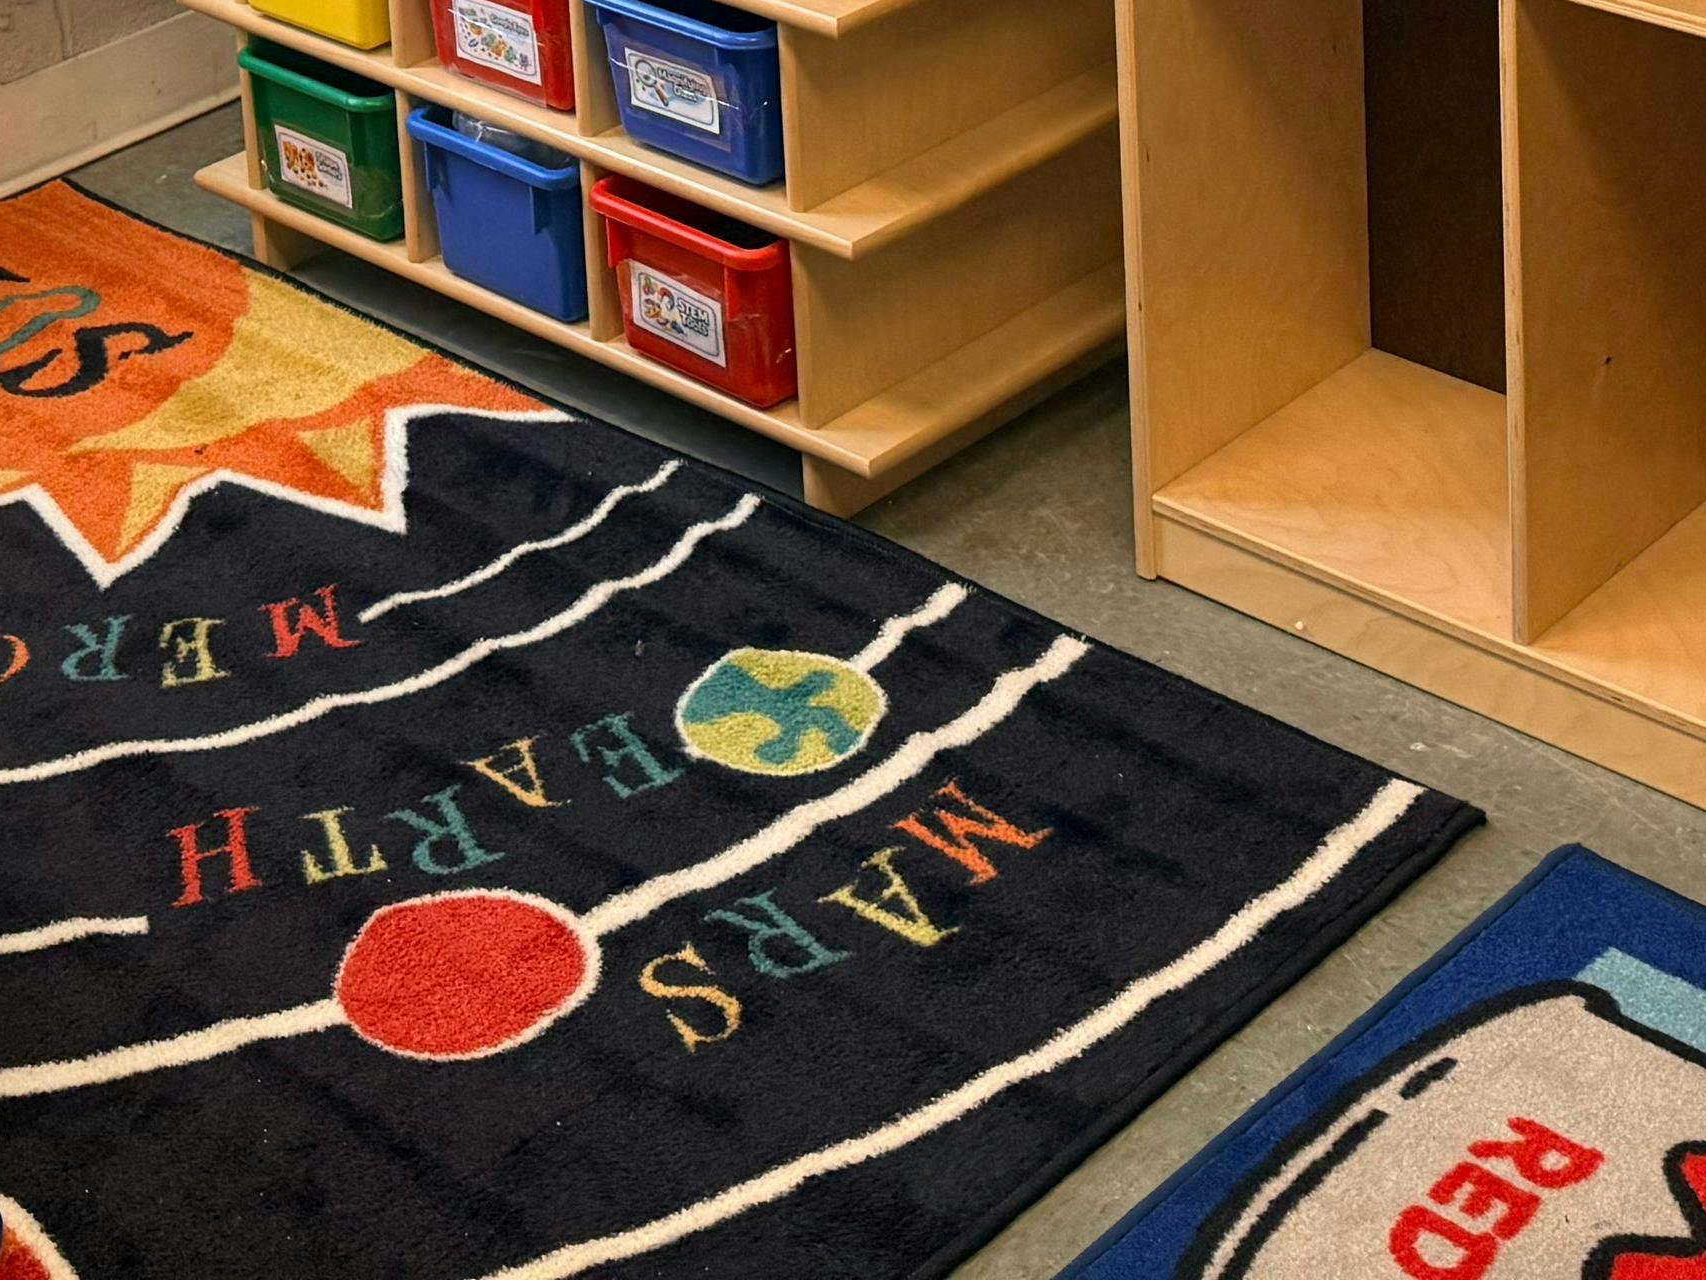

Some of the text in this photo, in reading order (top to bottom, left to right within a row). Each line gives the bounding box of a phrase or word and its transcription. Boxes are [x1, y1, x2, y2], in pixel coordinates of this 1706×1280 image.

[677, 297, 709, 323] STEM
[165, 708, 686, 910] EARTH
[636, 776, 1055, 1054] MARS
[1388, 1115, 1606, 1280] RED
